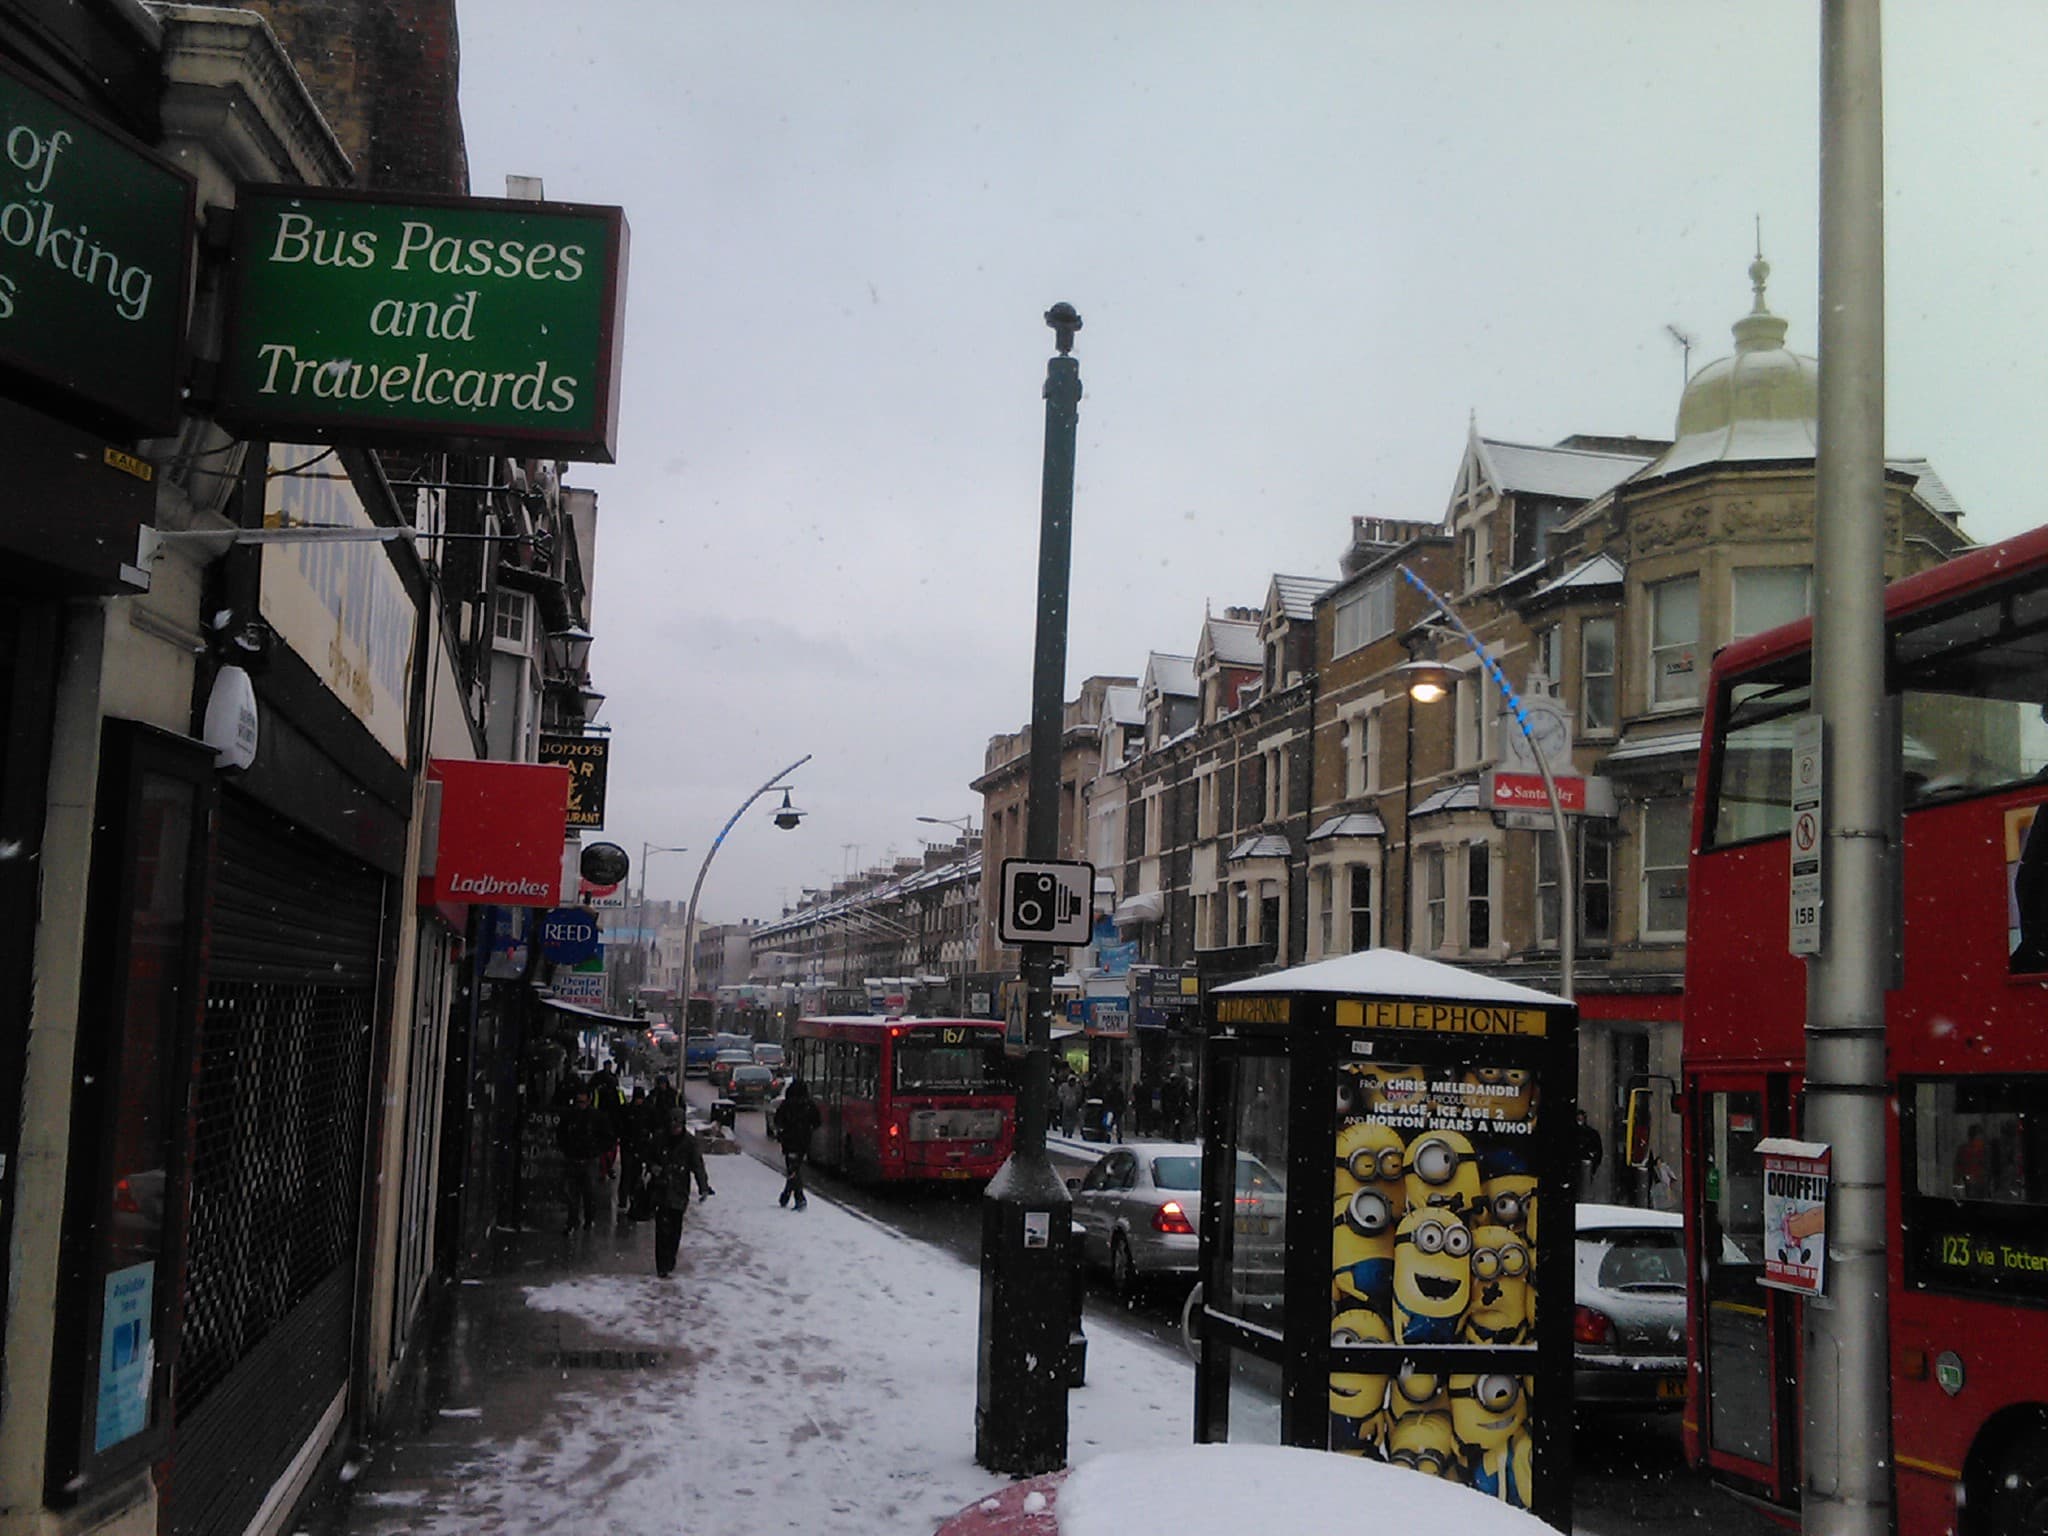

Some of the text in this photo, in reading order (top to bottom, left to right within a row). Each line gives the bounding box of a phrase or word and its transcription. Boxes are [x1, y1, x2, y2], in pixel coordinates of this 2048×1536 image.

[7, 126, 72, 193] of
[0, 200, 152, 320] oking
[269, 213, 585, 281] Bus Passes
[370, 291, 480, 341] and
[257, 343, 578, 412] Travelcards
[450, 873, 550, 897] Ladbrokes
[545, 923, 592, 942] REED
[552, 984, 604, 997] Practice
[1356, 1002, 1529, 1035] TELEPHONE
[1387, 1079, 1428, 1092] CHRIS
[1431, 1081, 1520, 1097] MELEDANDRI
[1366, 1113, 1425, 1129] HORTON
[1429, 1117, 1475, 1132] HEARS
[1477, 1120, 1489, 1133] A
[1491, 1121, 1533, 1136] WHO!
[1374, 1101, 1505, 1120] ICE AGE, ICE AGE 2
[1943, 1236, 1970, 1266] 123
[1975, 1248, 1995, 1266] via
